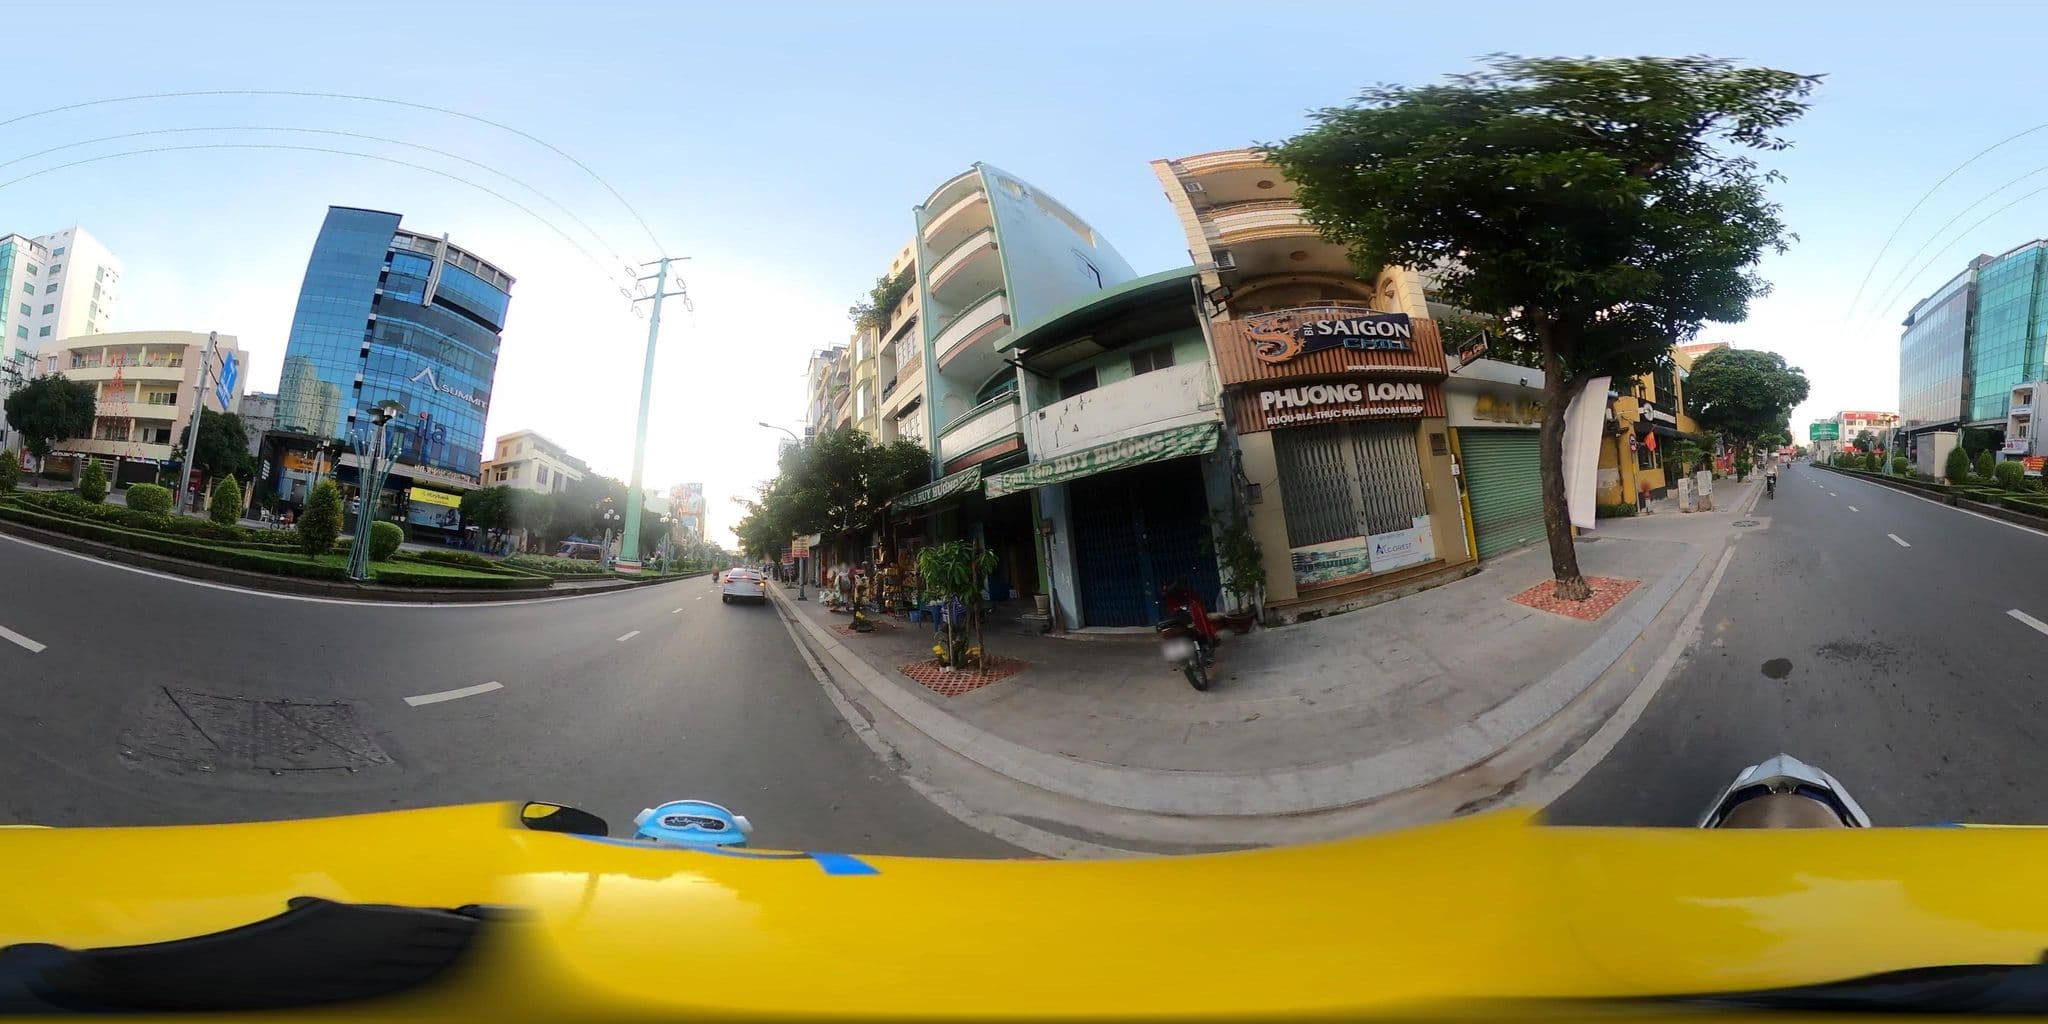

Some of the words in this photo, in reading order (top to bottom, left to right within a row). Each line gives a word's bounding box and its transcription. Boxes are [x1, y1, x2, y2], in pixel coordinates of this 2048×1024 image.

[1303, 321, 1314, 336] BIA
[1318, 320, 1411, 339] SAIGON
[440, 384, 488, 408] SUMMIT
[1260, 383, 1363, 411] PHƯƠNG
[1367, 382, 1424, 401] LOAN
[1054, 451, 1090, 474] HUY
